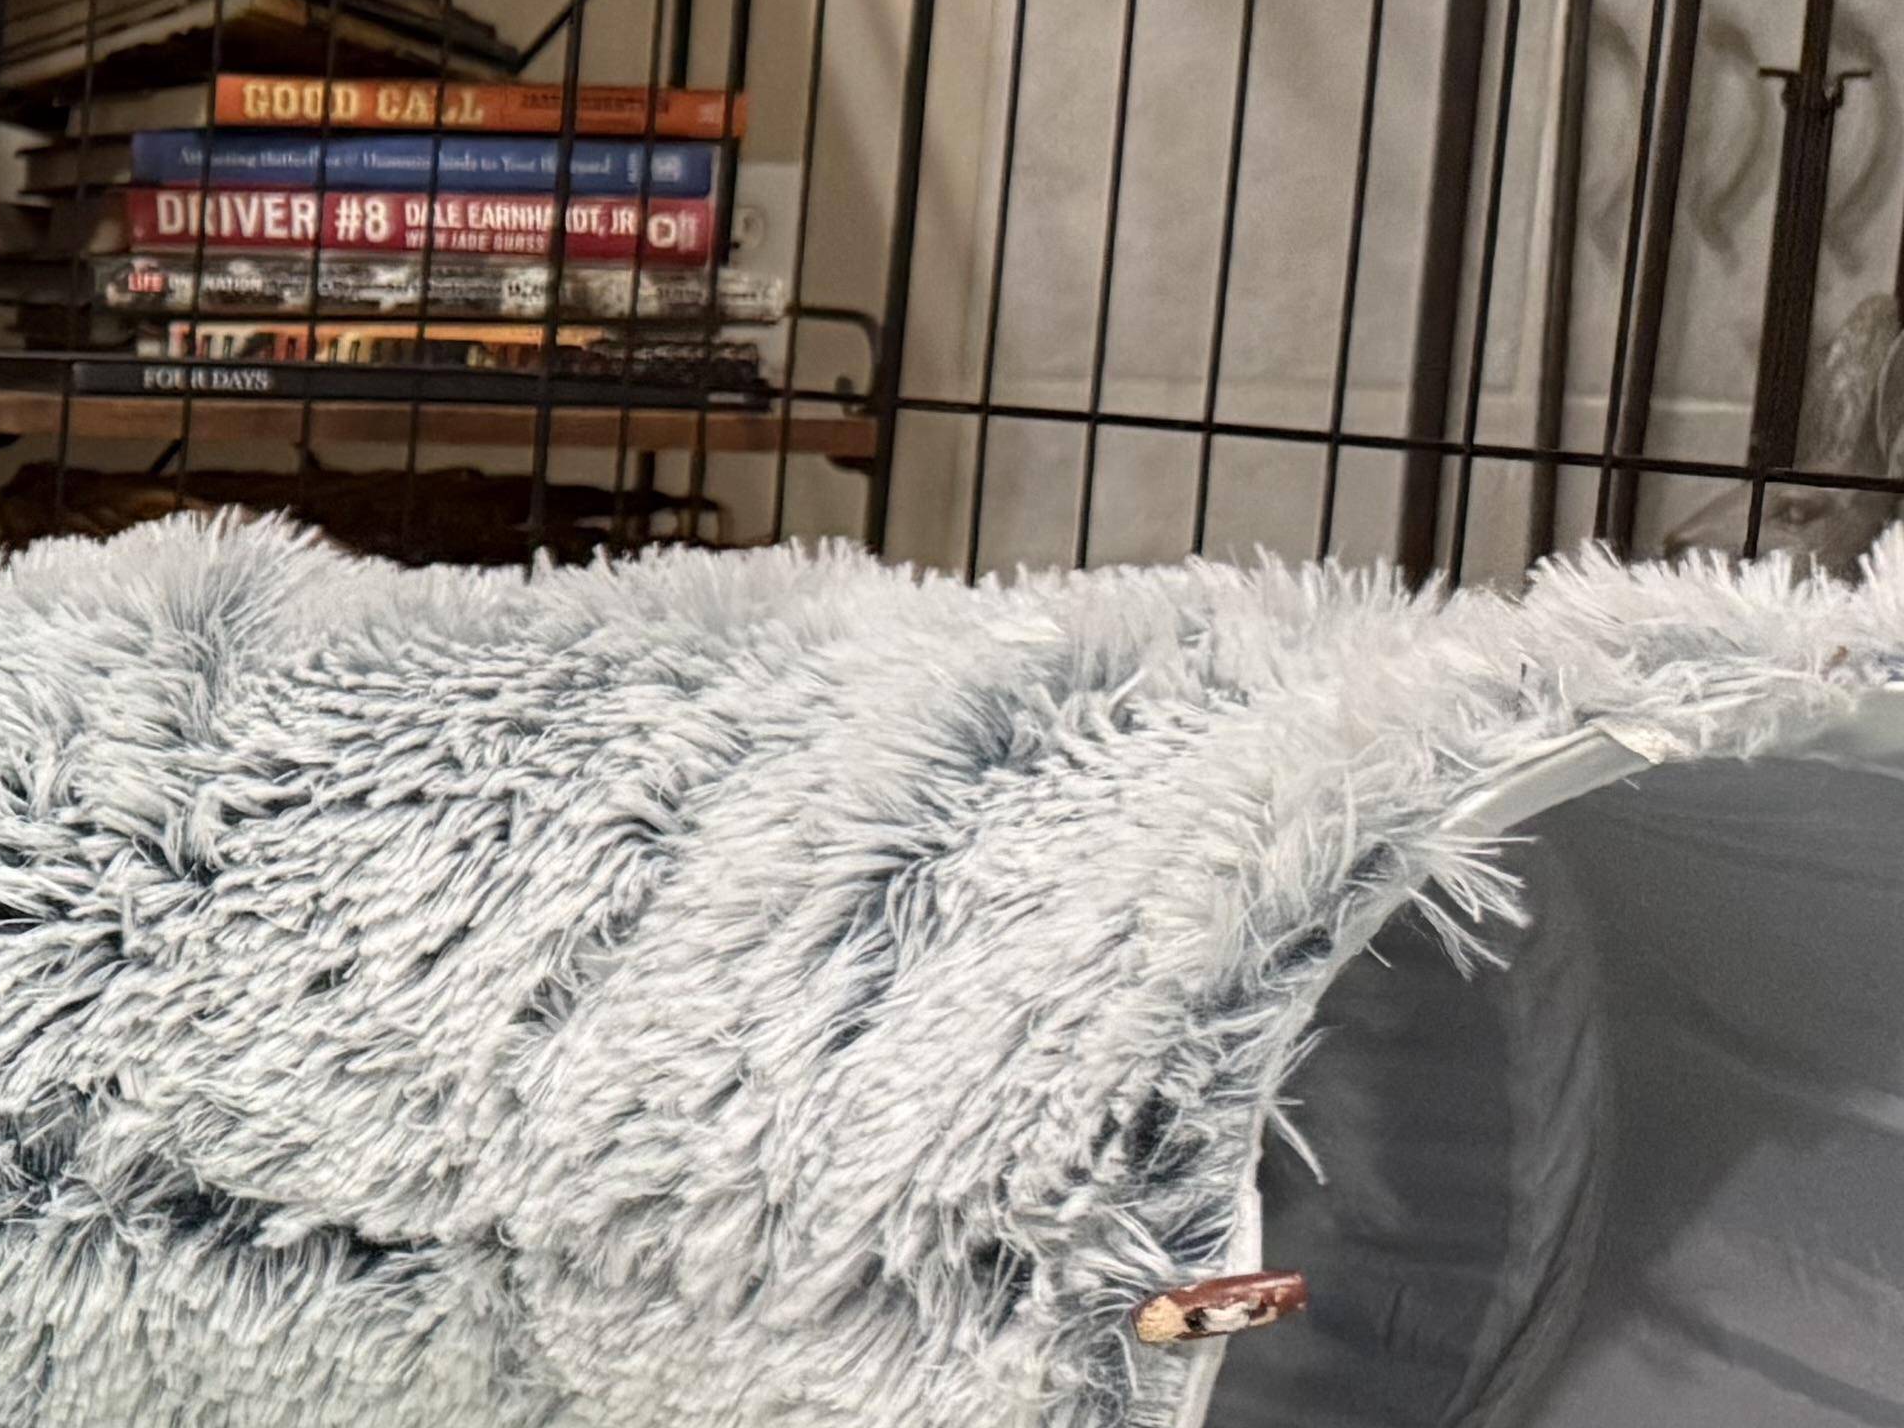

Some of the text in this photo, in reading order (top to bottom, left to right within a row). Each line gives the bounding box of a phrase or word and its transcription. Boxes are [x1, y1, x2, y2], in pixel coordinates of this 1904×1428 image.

[243, 81, 360, 121] GOOD
[157, 191, 392, 243] DRIVER #8
[212, 368, 270, 391] DAYS
